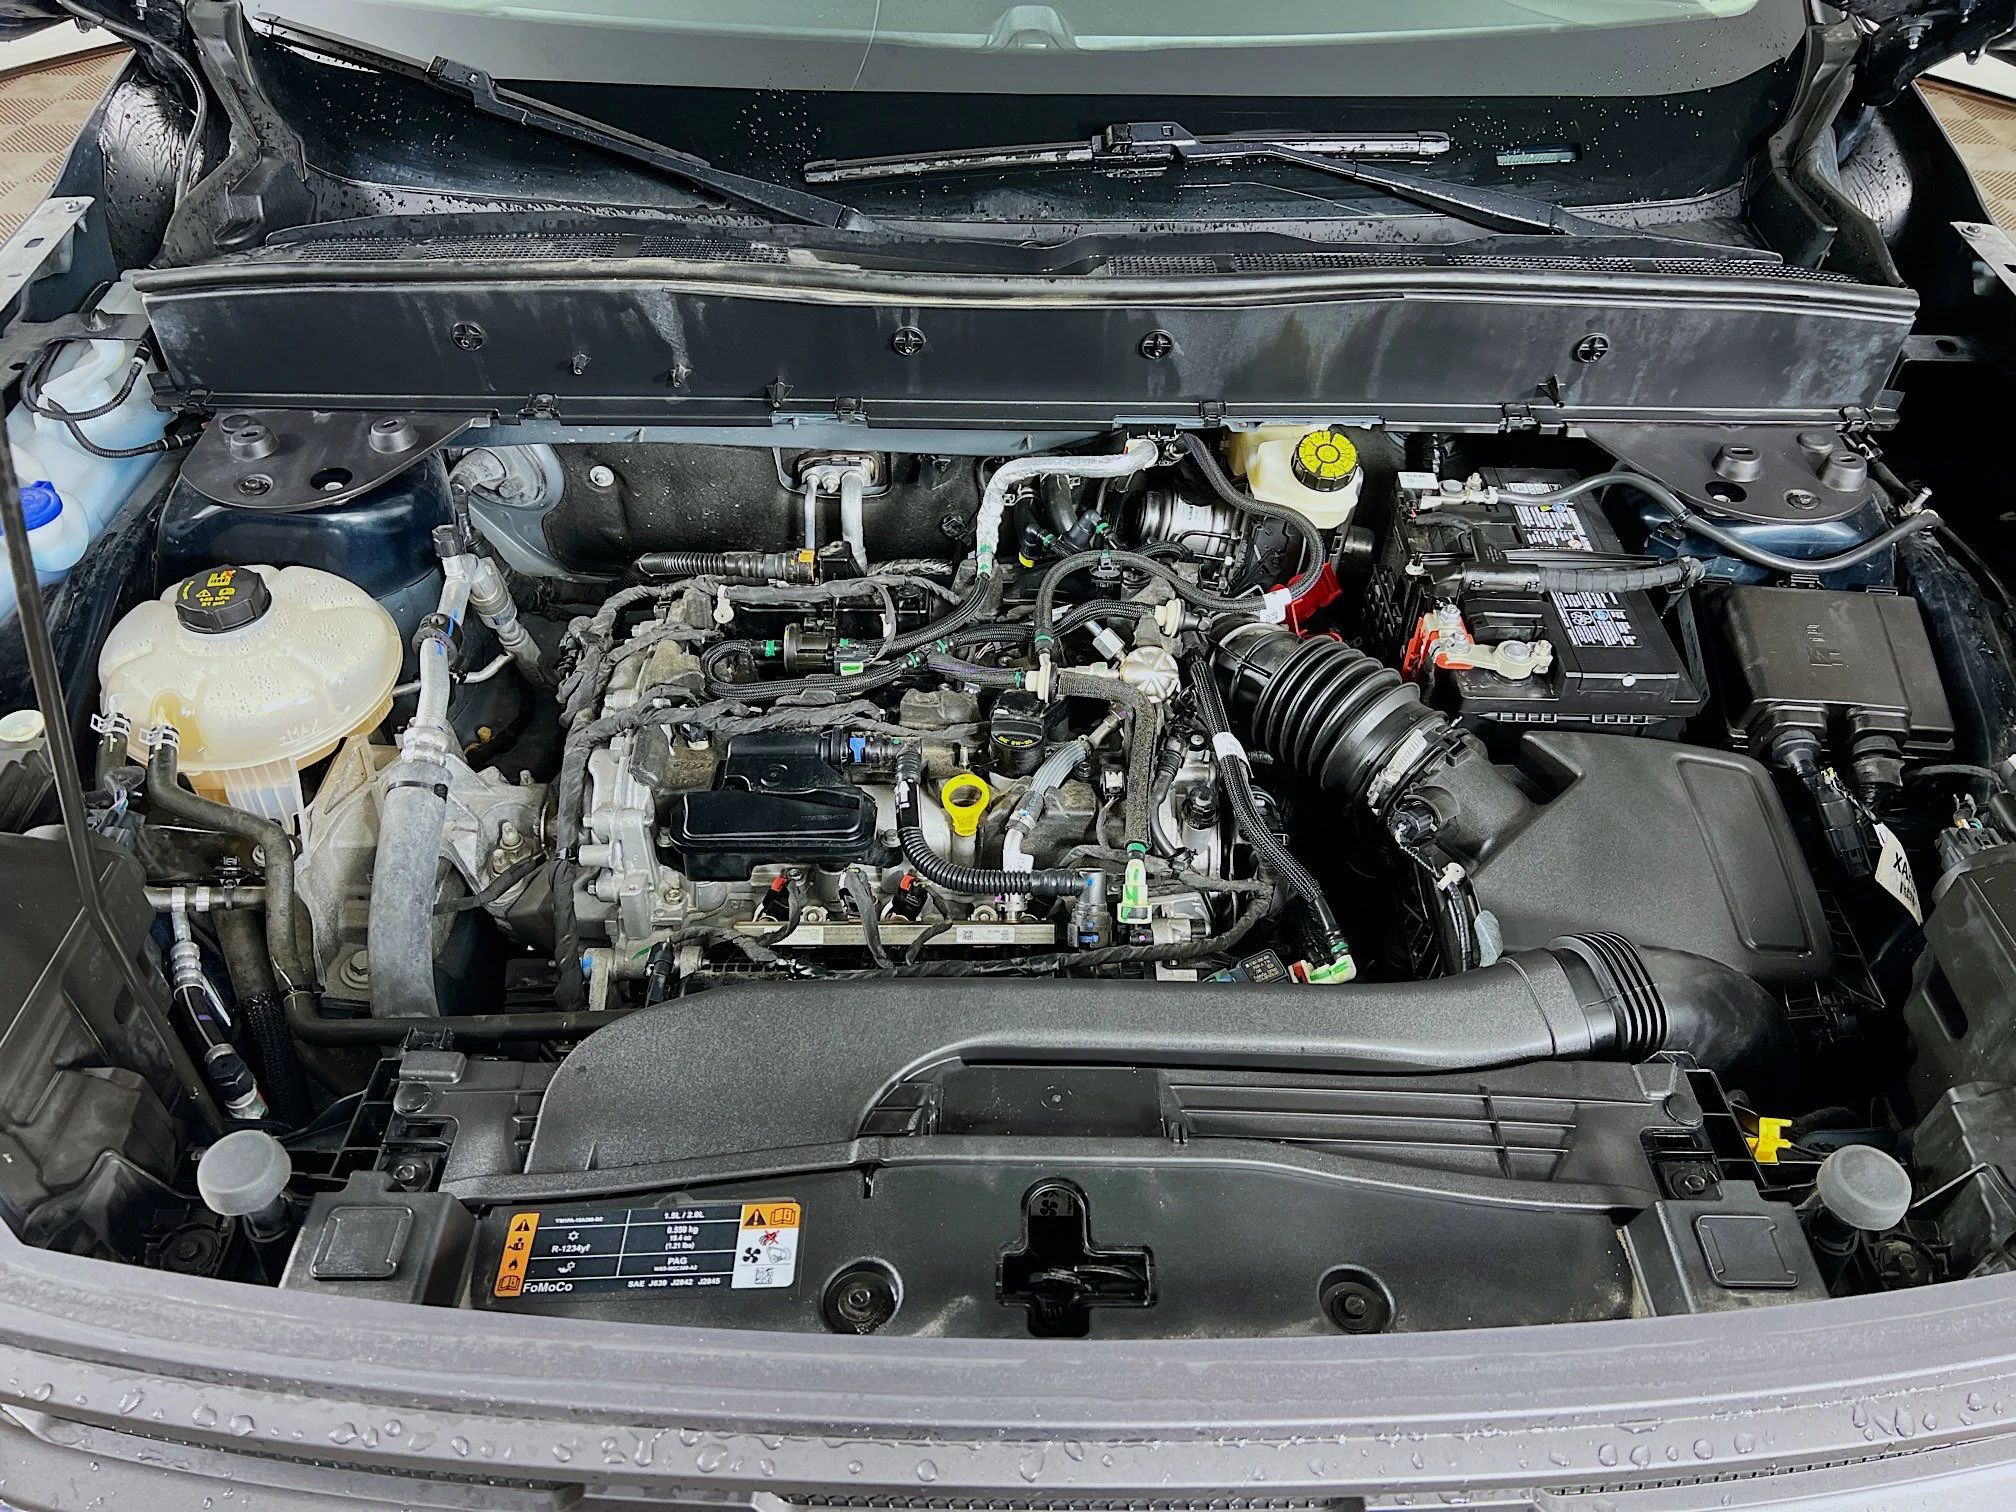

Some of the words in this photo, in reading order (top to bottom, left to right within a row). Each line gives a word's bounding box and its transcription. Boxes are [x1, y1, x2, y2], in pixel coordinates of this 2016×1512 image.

[664, 1211, 681, 1220] 1.5L
[687, 1210, 705, 1219] 2.0L
[688, 1226, 699, 1234] kg
[551, 1243, 591, 1254] R-1234yf
[682, 1241, 696, 1250] lbs)
[667, 1256, 688, 1266] PAG
[522, 1281, 573, 1294] FoMoCo
[628, 1280, 645, 1288] SAE
[648, 1279, 668, 1288] J639
[670, 1278, 694, 1287] J2842
[697, 1277, 721, 1286] J2845
